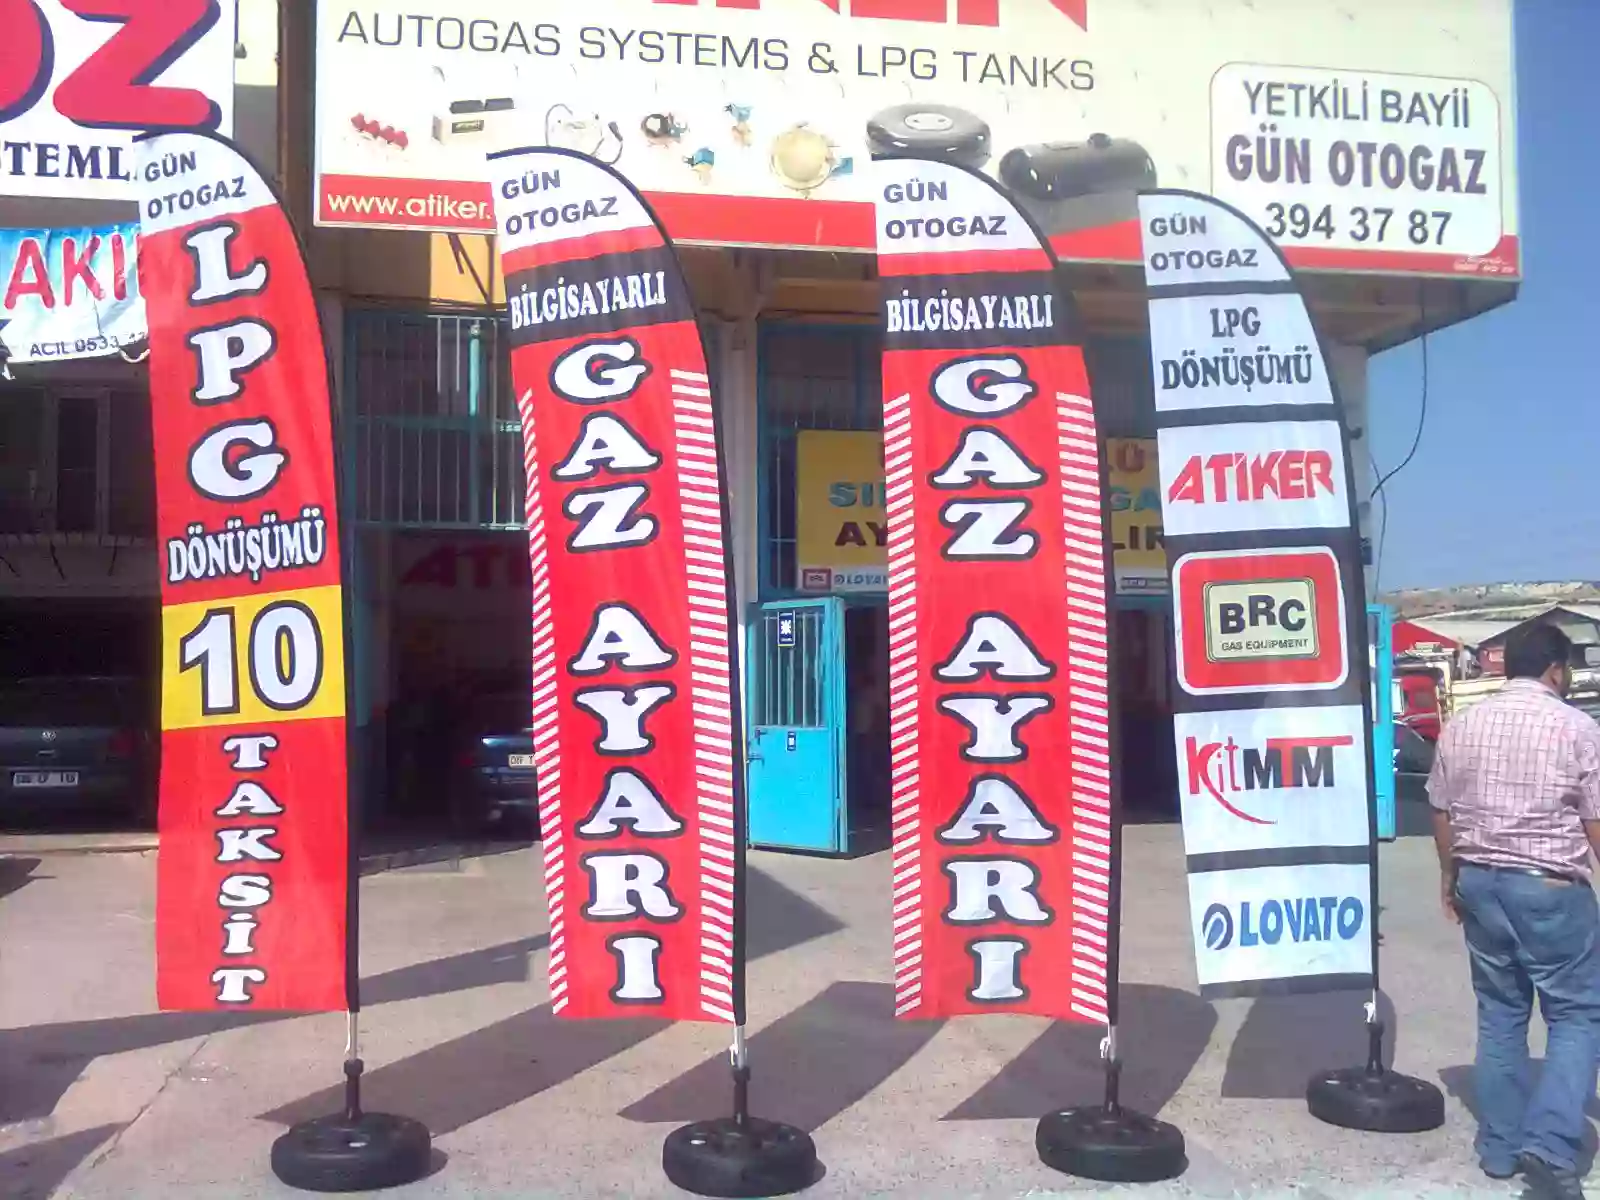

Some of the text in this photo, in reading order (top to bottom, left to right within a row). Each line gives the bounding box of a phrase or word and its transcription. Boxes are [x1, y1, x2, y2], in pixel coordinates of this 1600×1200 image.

[337, 11, 1094, 91] AUTOGAS SYSTEMS & LPG TANKS
[0, 141, 137, 181] TEML
[145, 151, 197, 182] GÜN
[1226, 123, 1487, 195] GÜN OTOGAZ
[147, 176, 248, 219] OTOGAZ
[502, 170, 561, 199] GÜN
[884, 179, 948, 204] GÜN
[505, 197, 619, 236] OTOGAZ
[885, 215, 1008, 240] OTOGAZ
[1149, 212, 1207, 236] GÜN
[1265, 203, 1453, 245] 394 37 87
[1150, 249, 1259, 270] OTOGAZ
[509, 271, 667, 329] BİLGİSAYARLI
[886, 289, 1054, 333] BİLGİSAYARLI
[1210, 306, 1261, 338] LPG
[183, 221, 289, 501] LPG
[1161, 346, 1312, 392] DÖNÜŞÜMÜ
[550, 337, 662, 553] GAZ
[929, 354, 1048, 561] GAZ
[168, 508, 325, 581] DÖNÜŞÜMÜ
[1219, 595, 1306, 634] BRC
[180, 600, 323, 715] 10
[1222, 638, 1309, 651] GAS EQUIPMENT
[567, 602, 685, 1001] AYARI
[933, 611, 1058, 1001] AYARI
[1240, 897, 1364, 946] LOVATO
